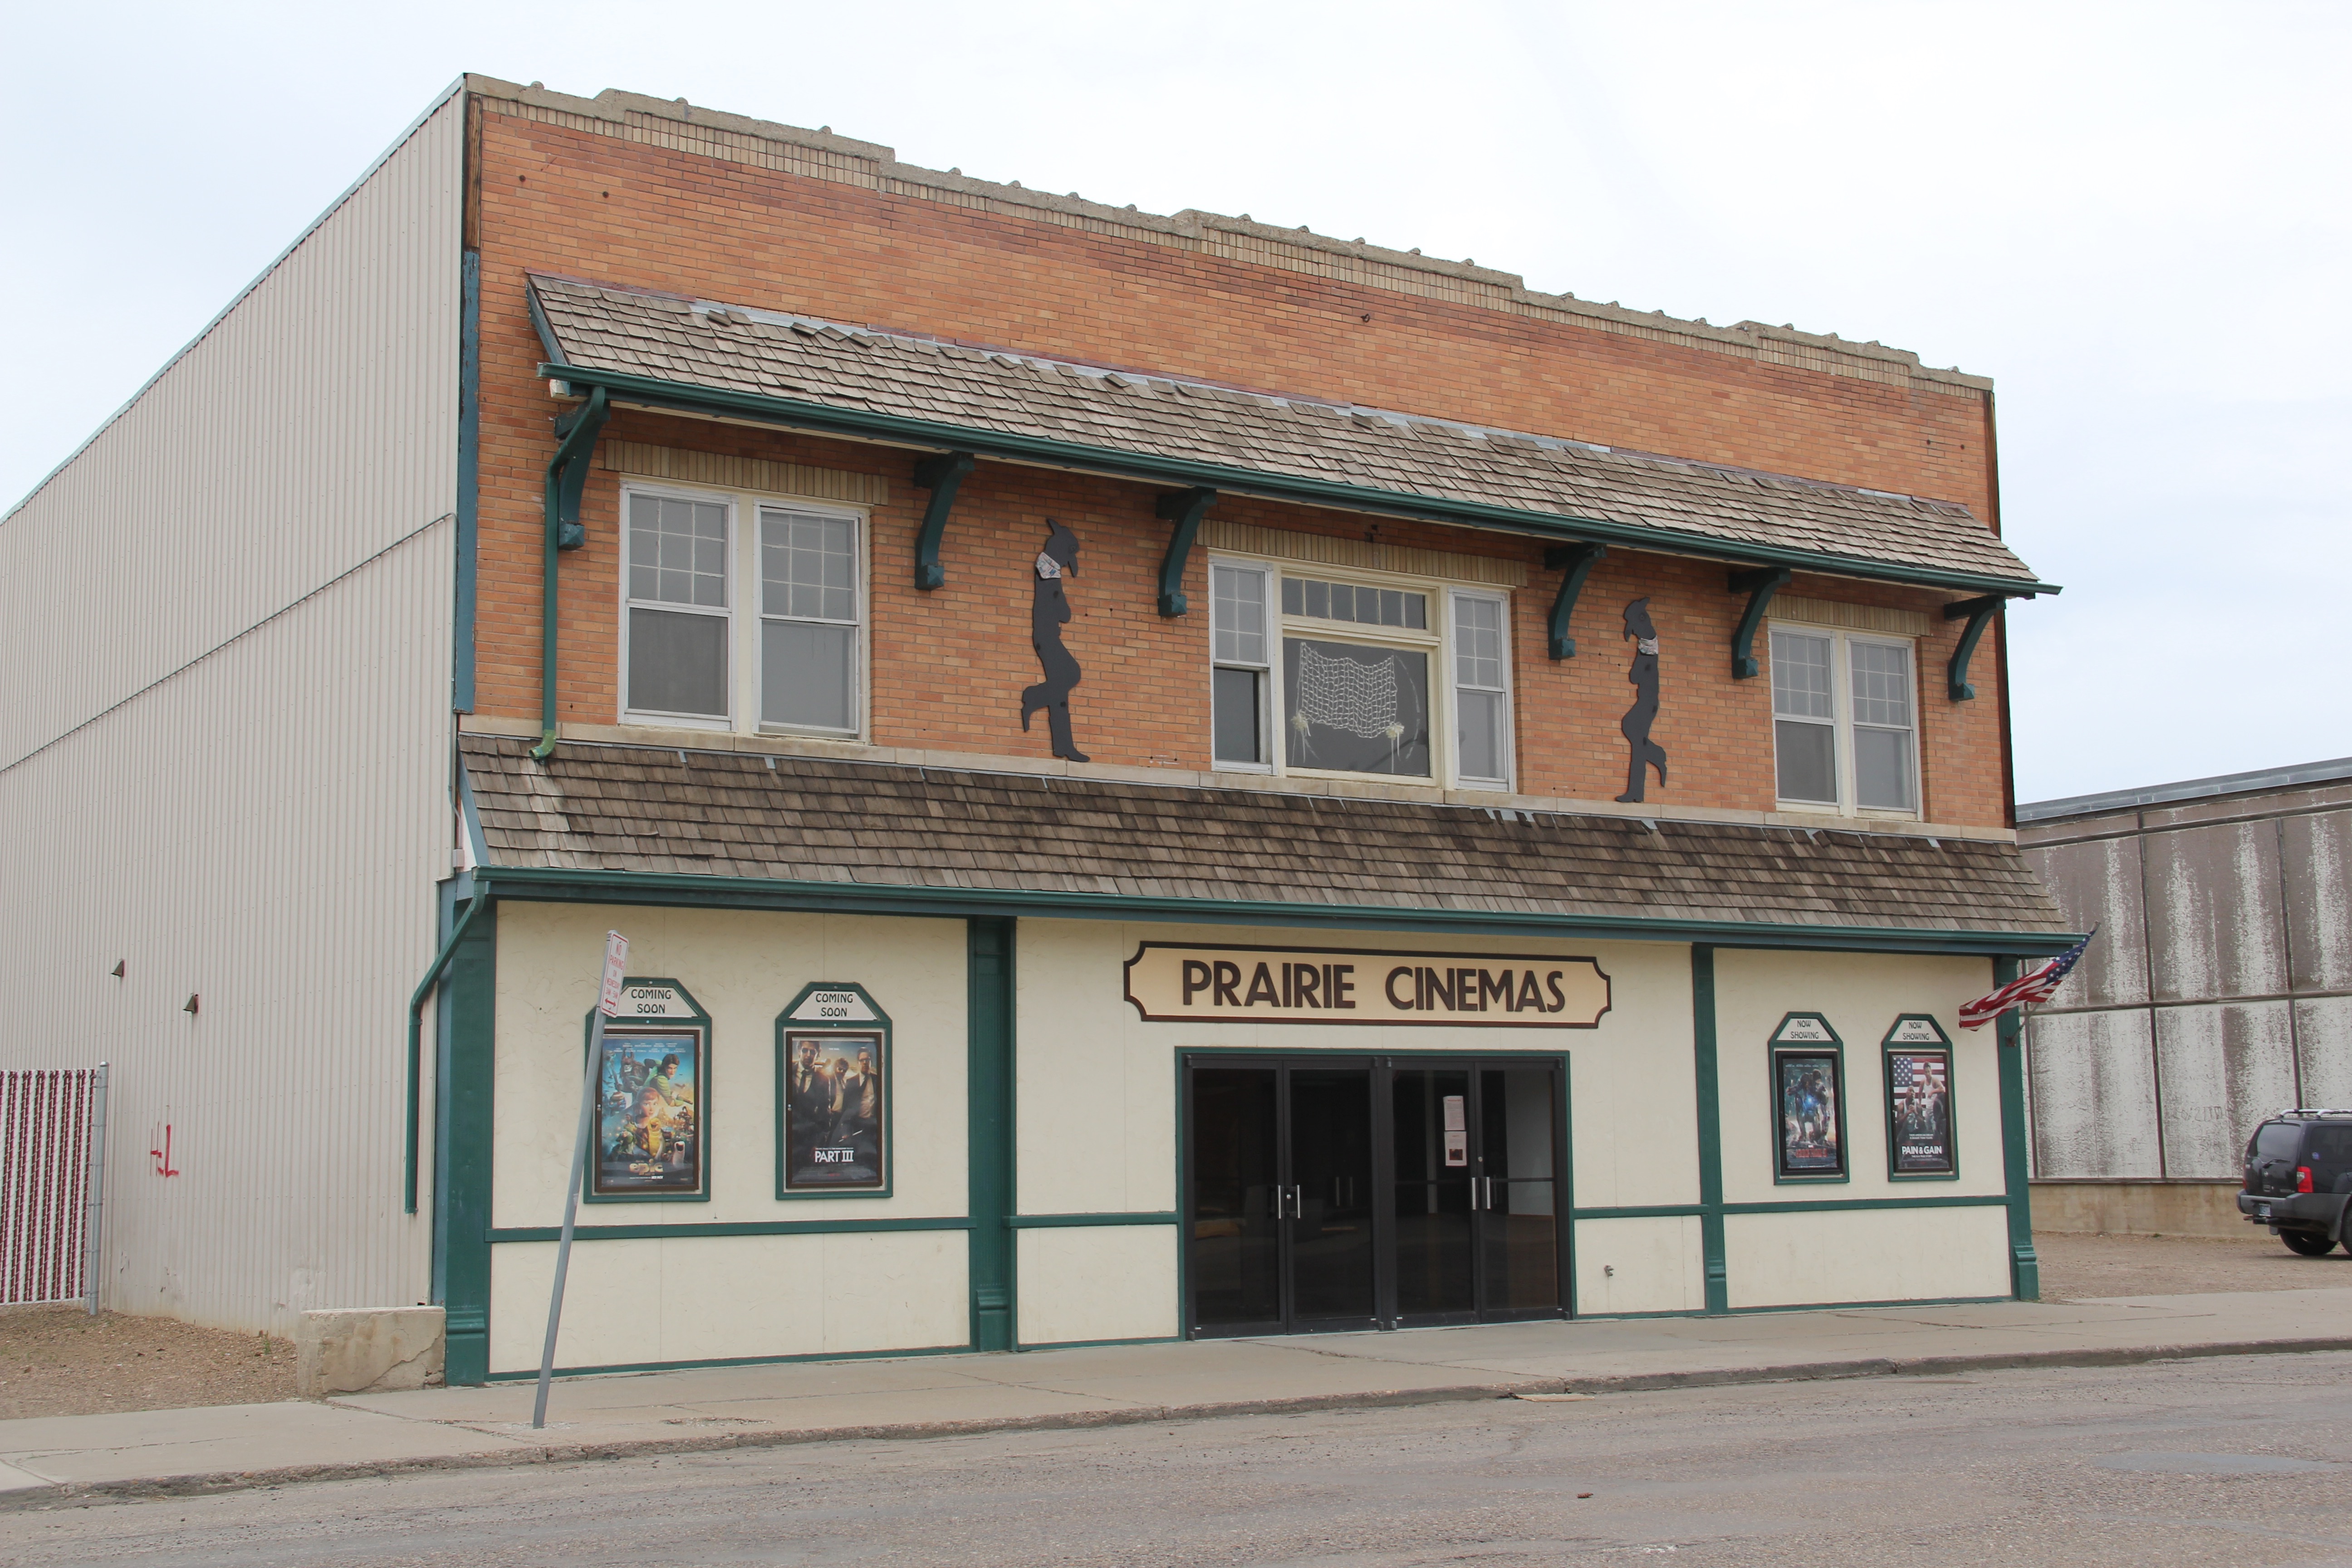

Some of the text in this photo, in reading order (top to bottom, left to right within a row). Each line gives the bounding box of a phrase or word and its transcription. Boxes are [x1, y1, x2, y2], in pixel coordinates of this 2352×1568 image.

[616, 943, 622, 956] NO
[608, 955, 625, 970] PARKING
[1183, 960, 1565, 1013] PRAIRIE CINEMAS
[631, 989, 671, 1000] COMING
[816, 993, 853, 1003] COMING
[637, 1003, 666, 1014] SOON
[820, 1007, 847, 1017] SOON
[1902, 1032, 1930, 1040] SHOWING
[815, 1150, 854, 1162] PART III
[1901, 1146, 1918, 1155] PAIN
[1924, 1146, 1942, 1154] GAIN
[629, 1158, 664, 1175] epic
